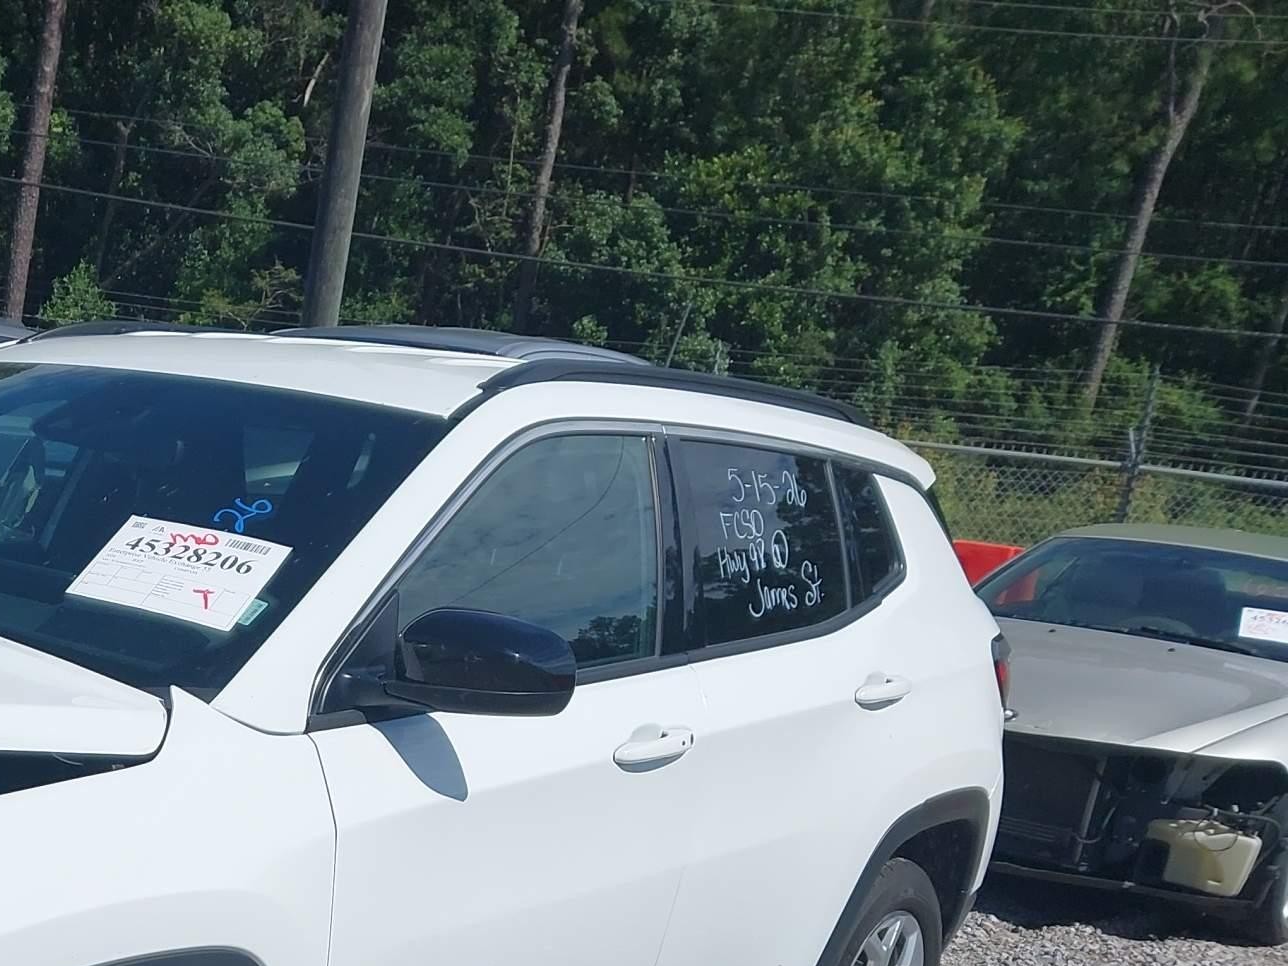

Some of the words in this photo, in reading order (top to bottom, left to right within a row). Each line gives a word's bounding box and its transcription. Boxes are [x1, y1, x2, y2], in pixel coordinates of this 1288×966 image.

[727, 468, 808, 507] 5-15-26
[125, 536, 254, 576] 45328206
[717, 546, 750, 583] Hwy
[749, 538, 767, 571] 98
